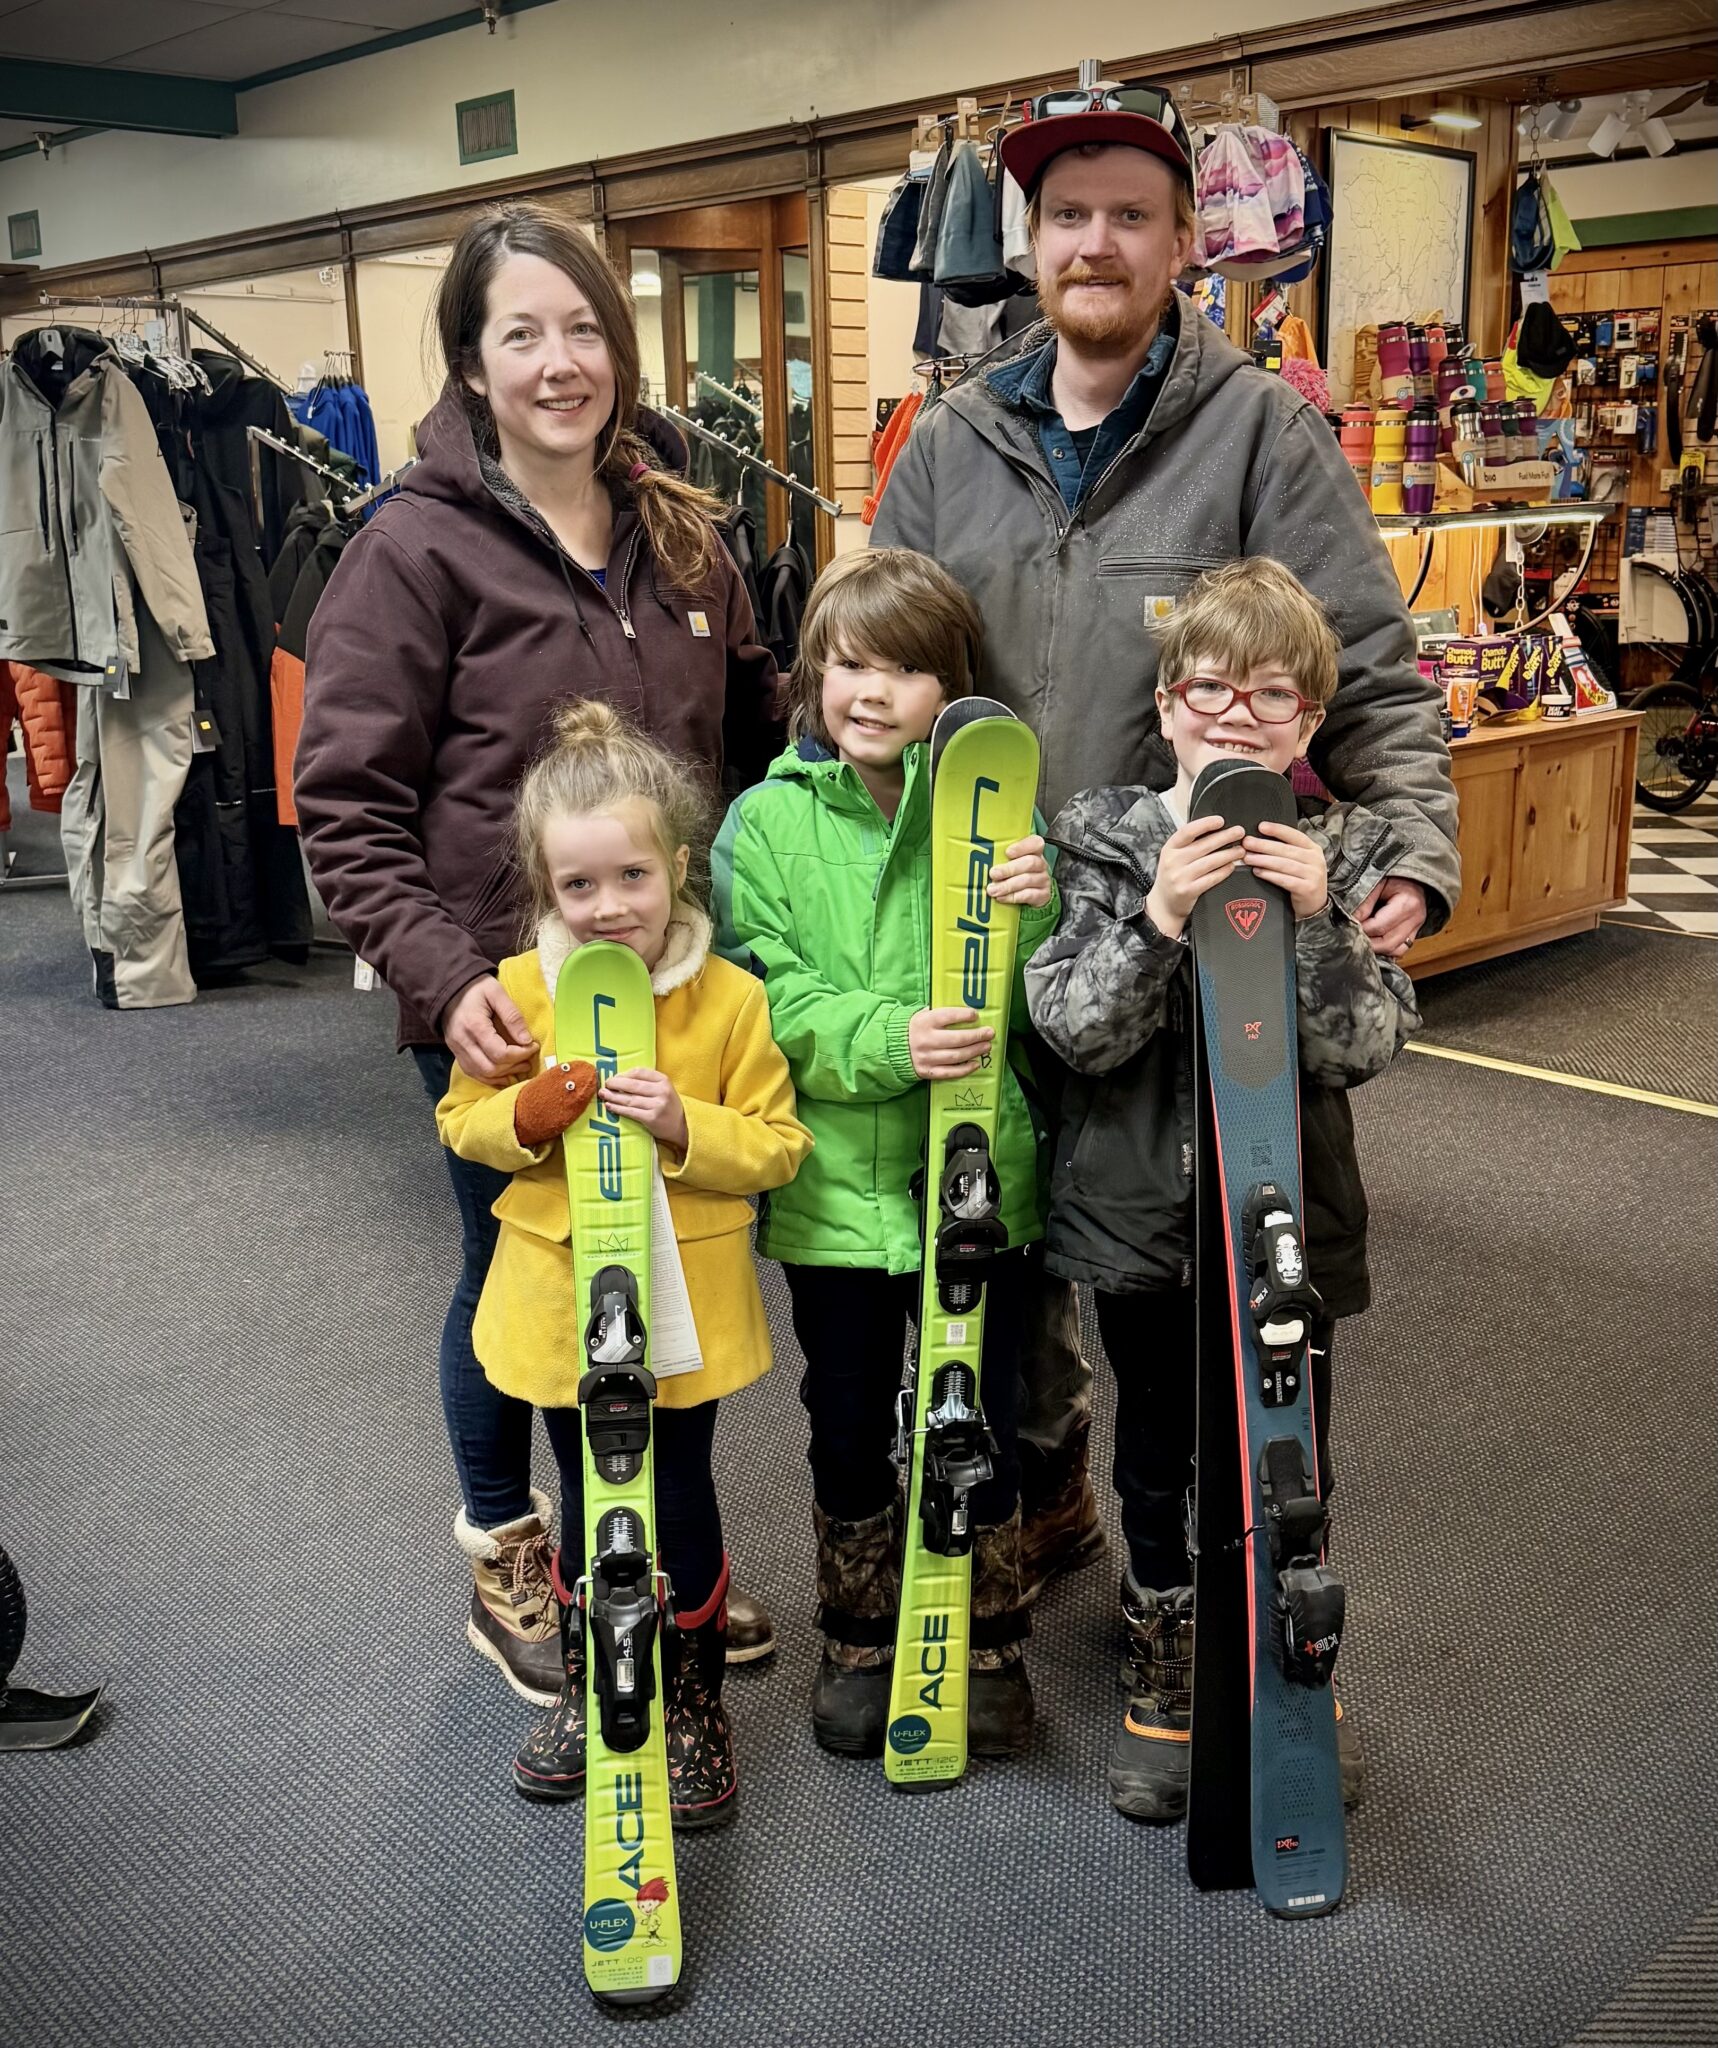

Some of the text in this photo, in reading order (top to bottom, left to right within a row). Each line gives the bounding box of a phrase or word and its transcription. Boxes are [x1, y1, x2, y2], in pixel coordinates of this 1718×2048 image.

[957, 776, 1000, 1009] elan
[622, 1637, 631, 1658] 4.5
[919, 1614, 949, 1711] ACE
[893, 1729, 926, 1738] U-FLEX
[895, 1758, 932, 1767] JETT
[615, 1772, 644, 1892] ACE
[589, 1917, 629, 1930] U-FLEX
[591, 1958, 620, 1967] JETT
